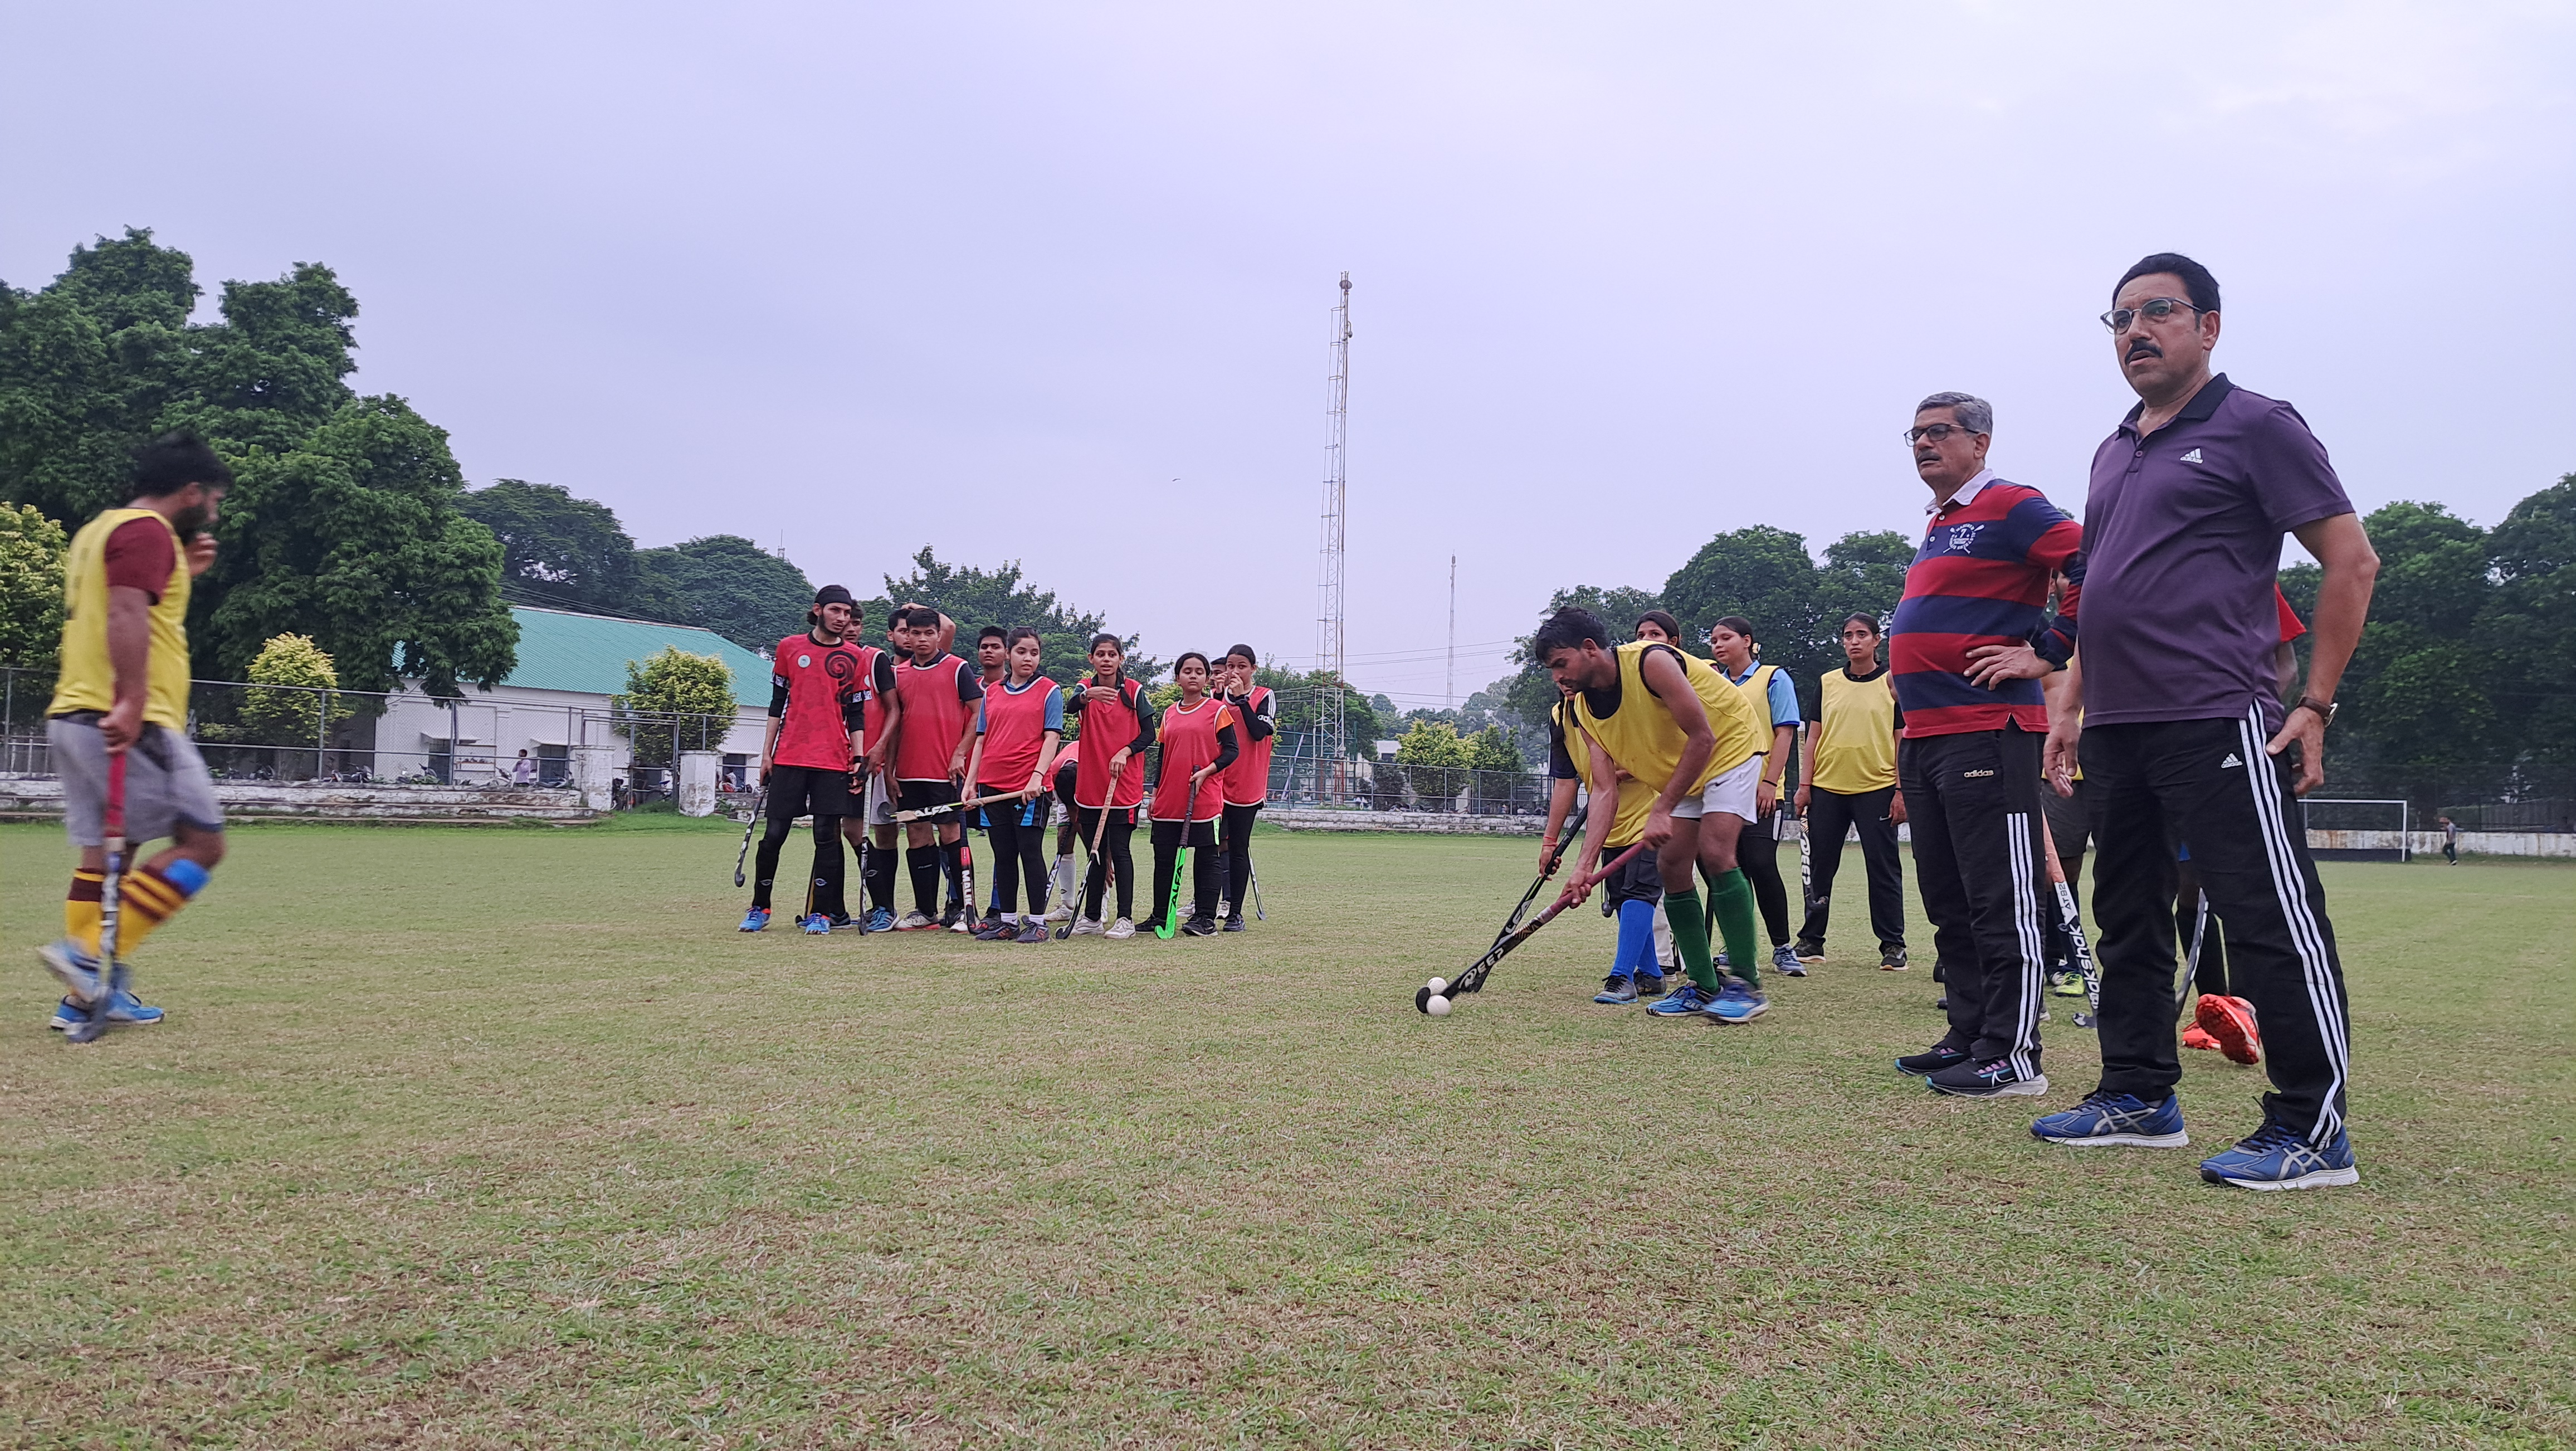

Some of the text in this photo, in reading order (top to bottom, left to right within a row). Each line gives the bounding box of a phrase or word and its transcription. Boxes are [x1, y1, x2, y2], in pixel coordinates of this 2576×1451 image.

[1964, 769, 1994, 778] adidas
[914, 805, 954, 817] ALFA
[962, 869, 973, 907] MALIK
[1169, 864, 1184, 914] ALFA
